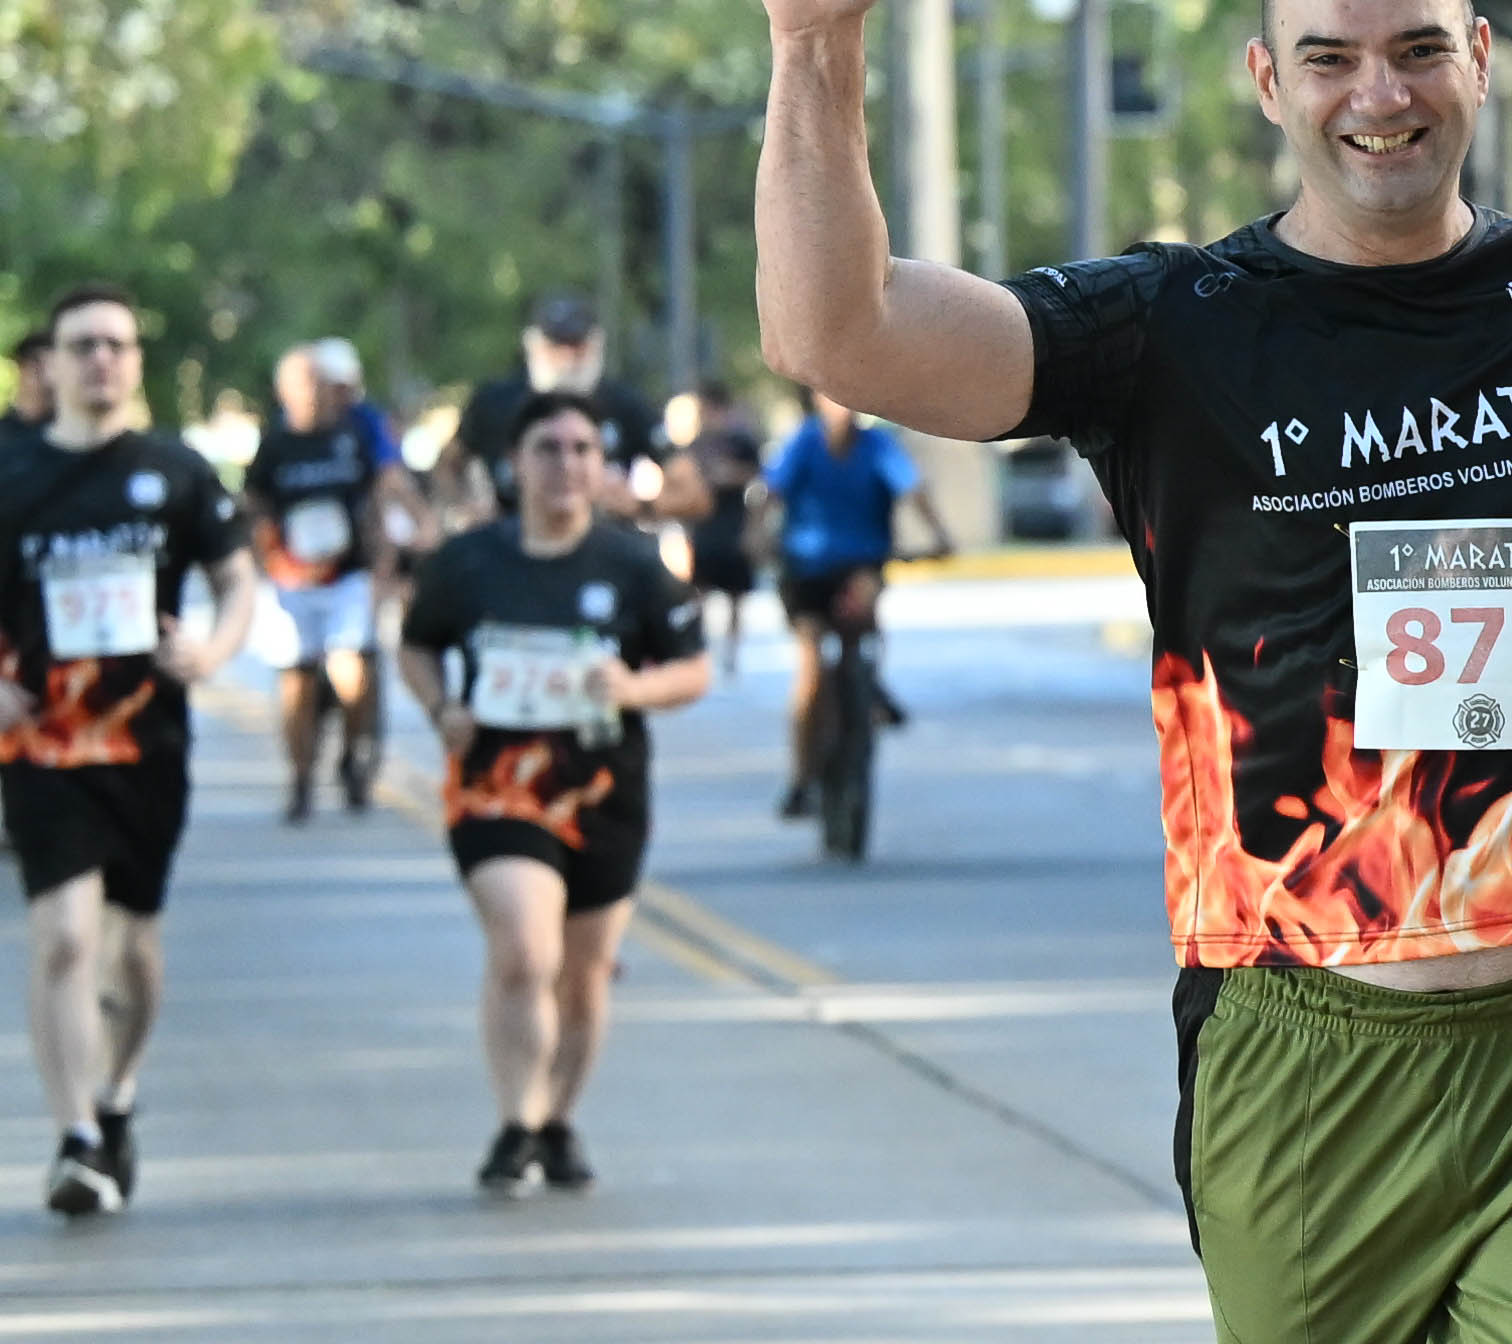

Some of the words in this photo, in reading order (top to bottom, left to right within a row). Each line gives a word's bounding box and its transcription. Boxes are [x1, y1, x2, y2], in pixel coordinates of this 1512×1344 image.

[1252, 486, 1354, 513] ASOCIACIÓN
[1359, 470, 1454, 504] BOMBEROS
[1366, 575, 1425, 591] ASOCIACIÓN
[1428, 576, 1480, 589] BOMBEROS
[1470, 710, 1491, 729] 27
